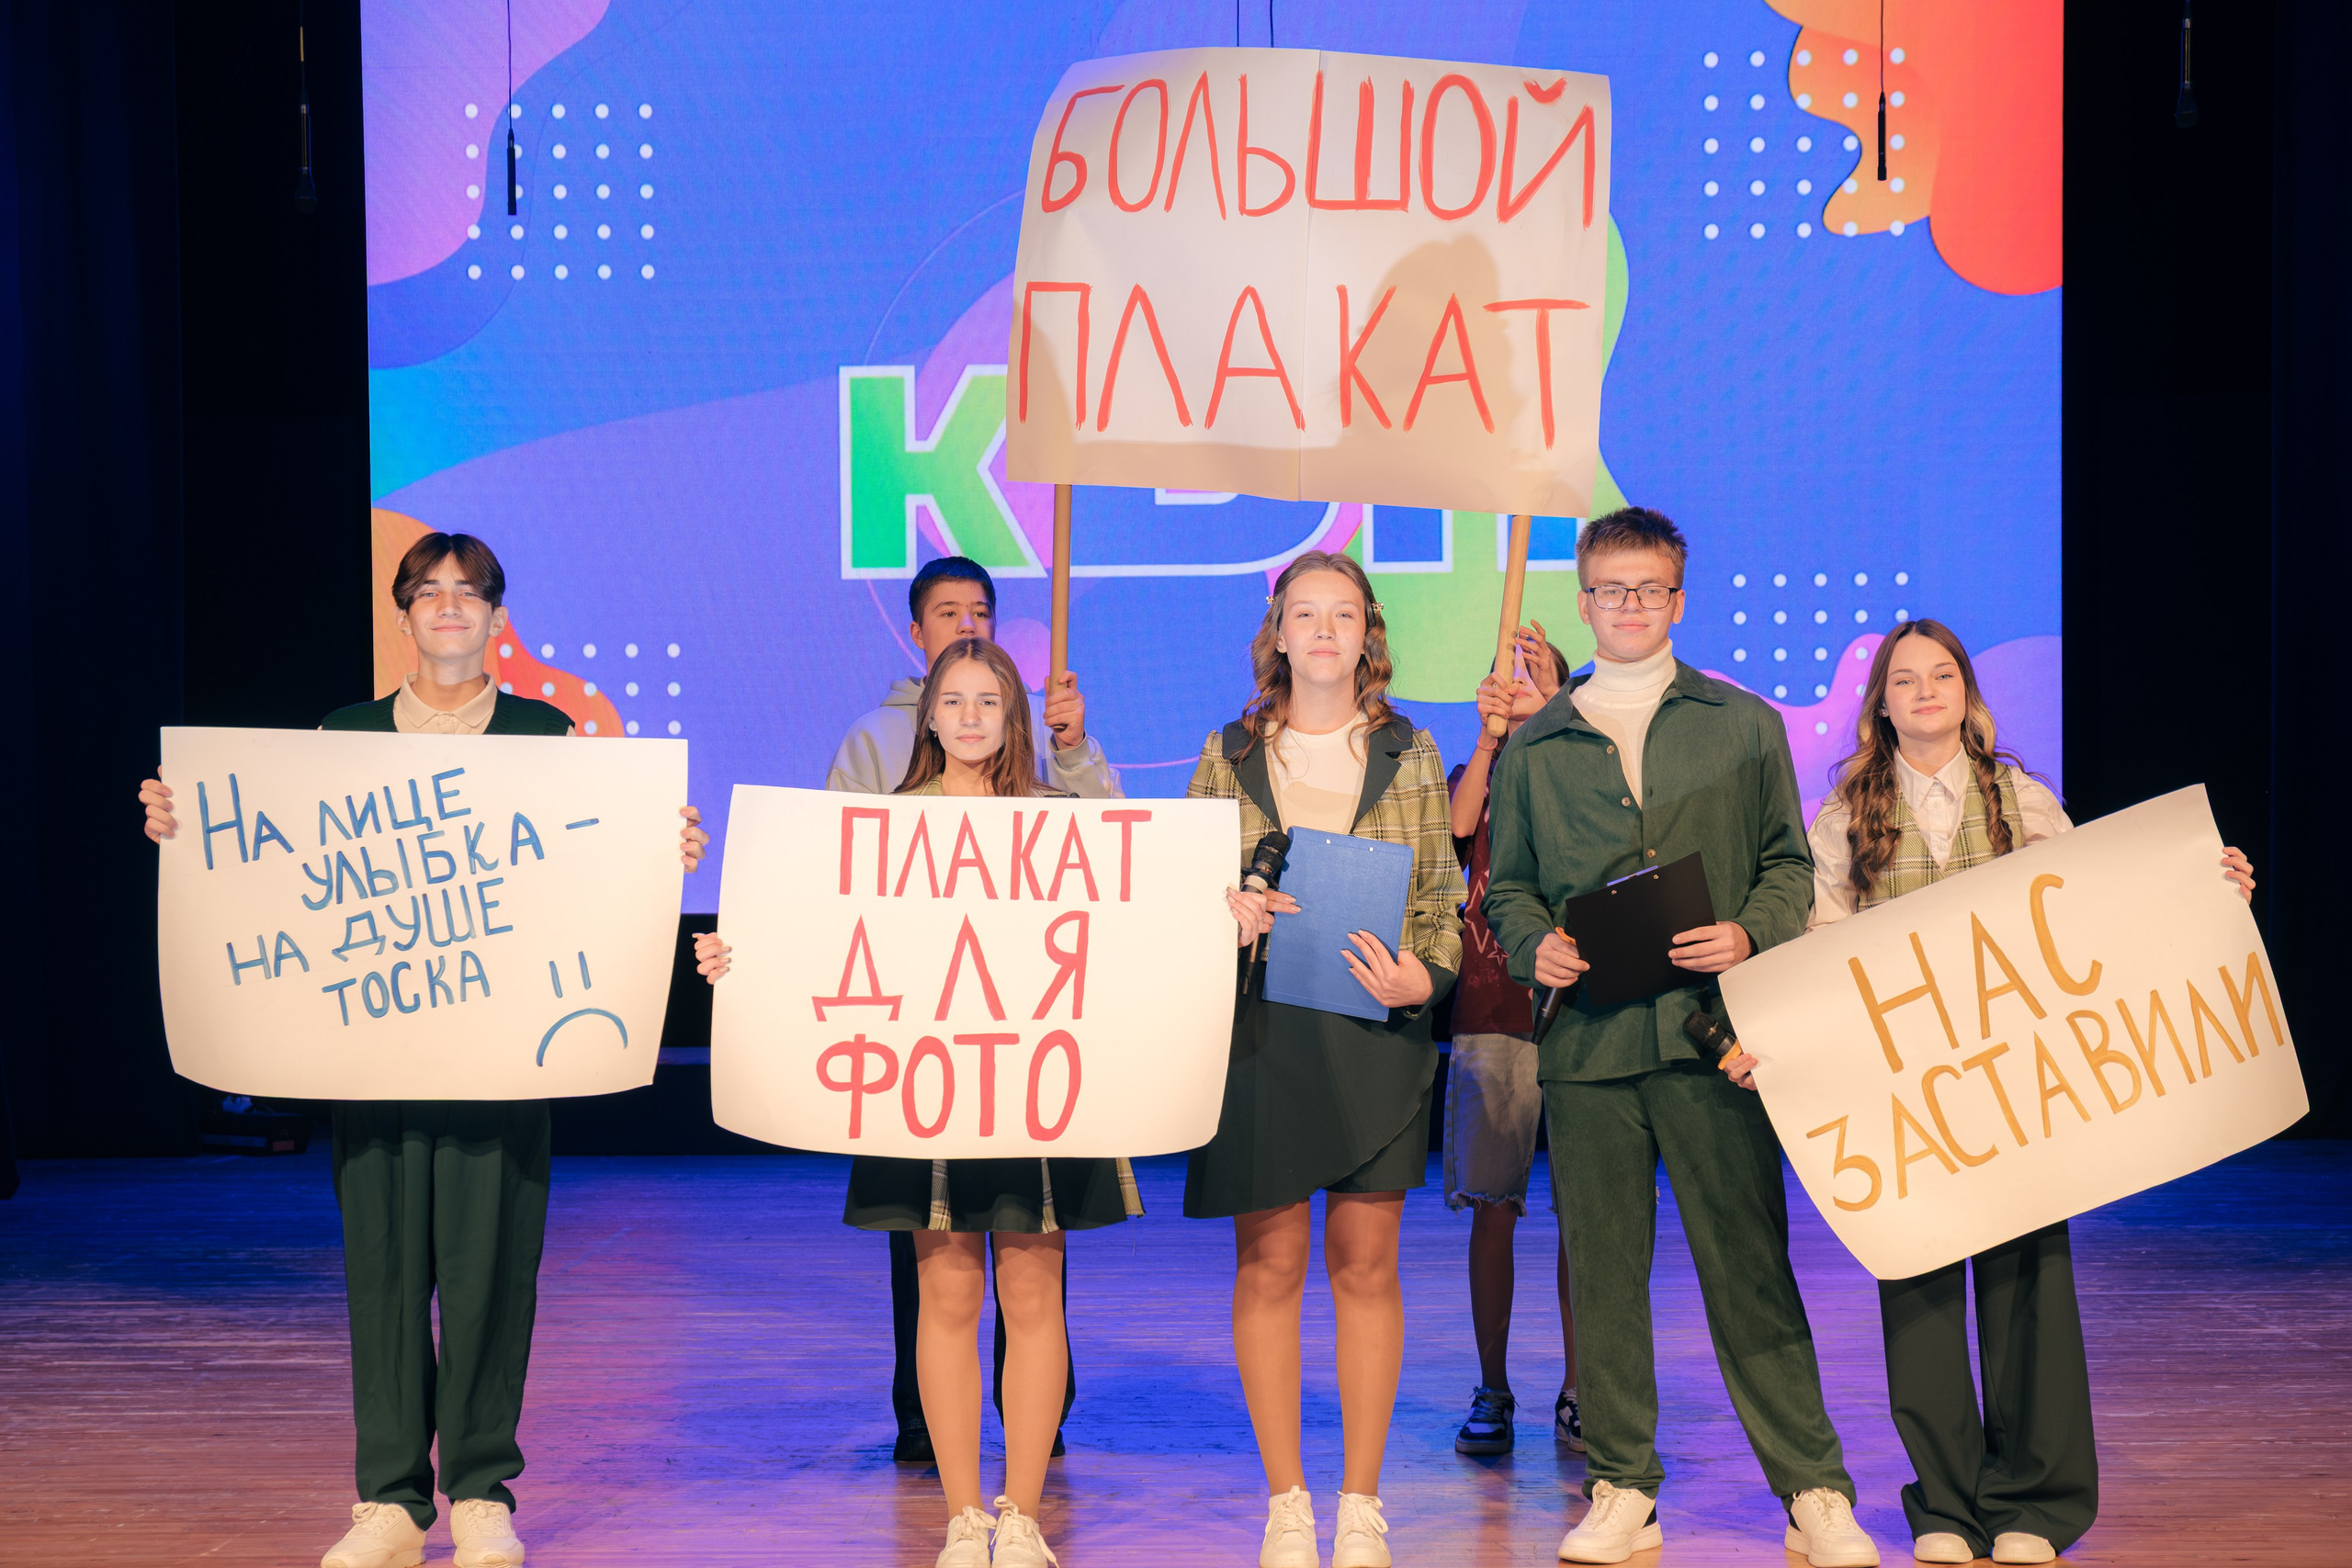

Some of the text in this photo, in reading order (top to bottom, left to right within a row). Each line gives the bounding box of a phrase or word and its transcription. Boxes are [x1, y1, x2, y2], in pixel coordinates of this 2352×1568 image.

[1041, 70, 1596, 229] БОЛЬШОЙ
[1018, 281, 1590, 449] ПЛАКАТ
[319, 766, 472, 846] ЛИЦЕ
[839, 806, 1152, 902] ПЛАКАТ
[227, 876, 514, 986] НА ДУШЕ
[811, 910, 1090, 1021] ДЛЯ
[1848, 873, 2103, 1074] НАС
[322, 950, 491, 1026] ТОСКА
[816, 1029, 1082, 1142] ФОТО
[1805, 951, 2286, 1212] ЗАСТАВИЛИ
